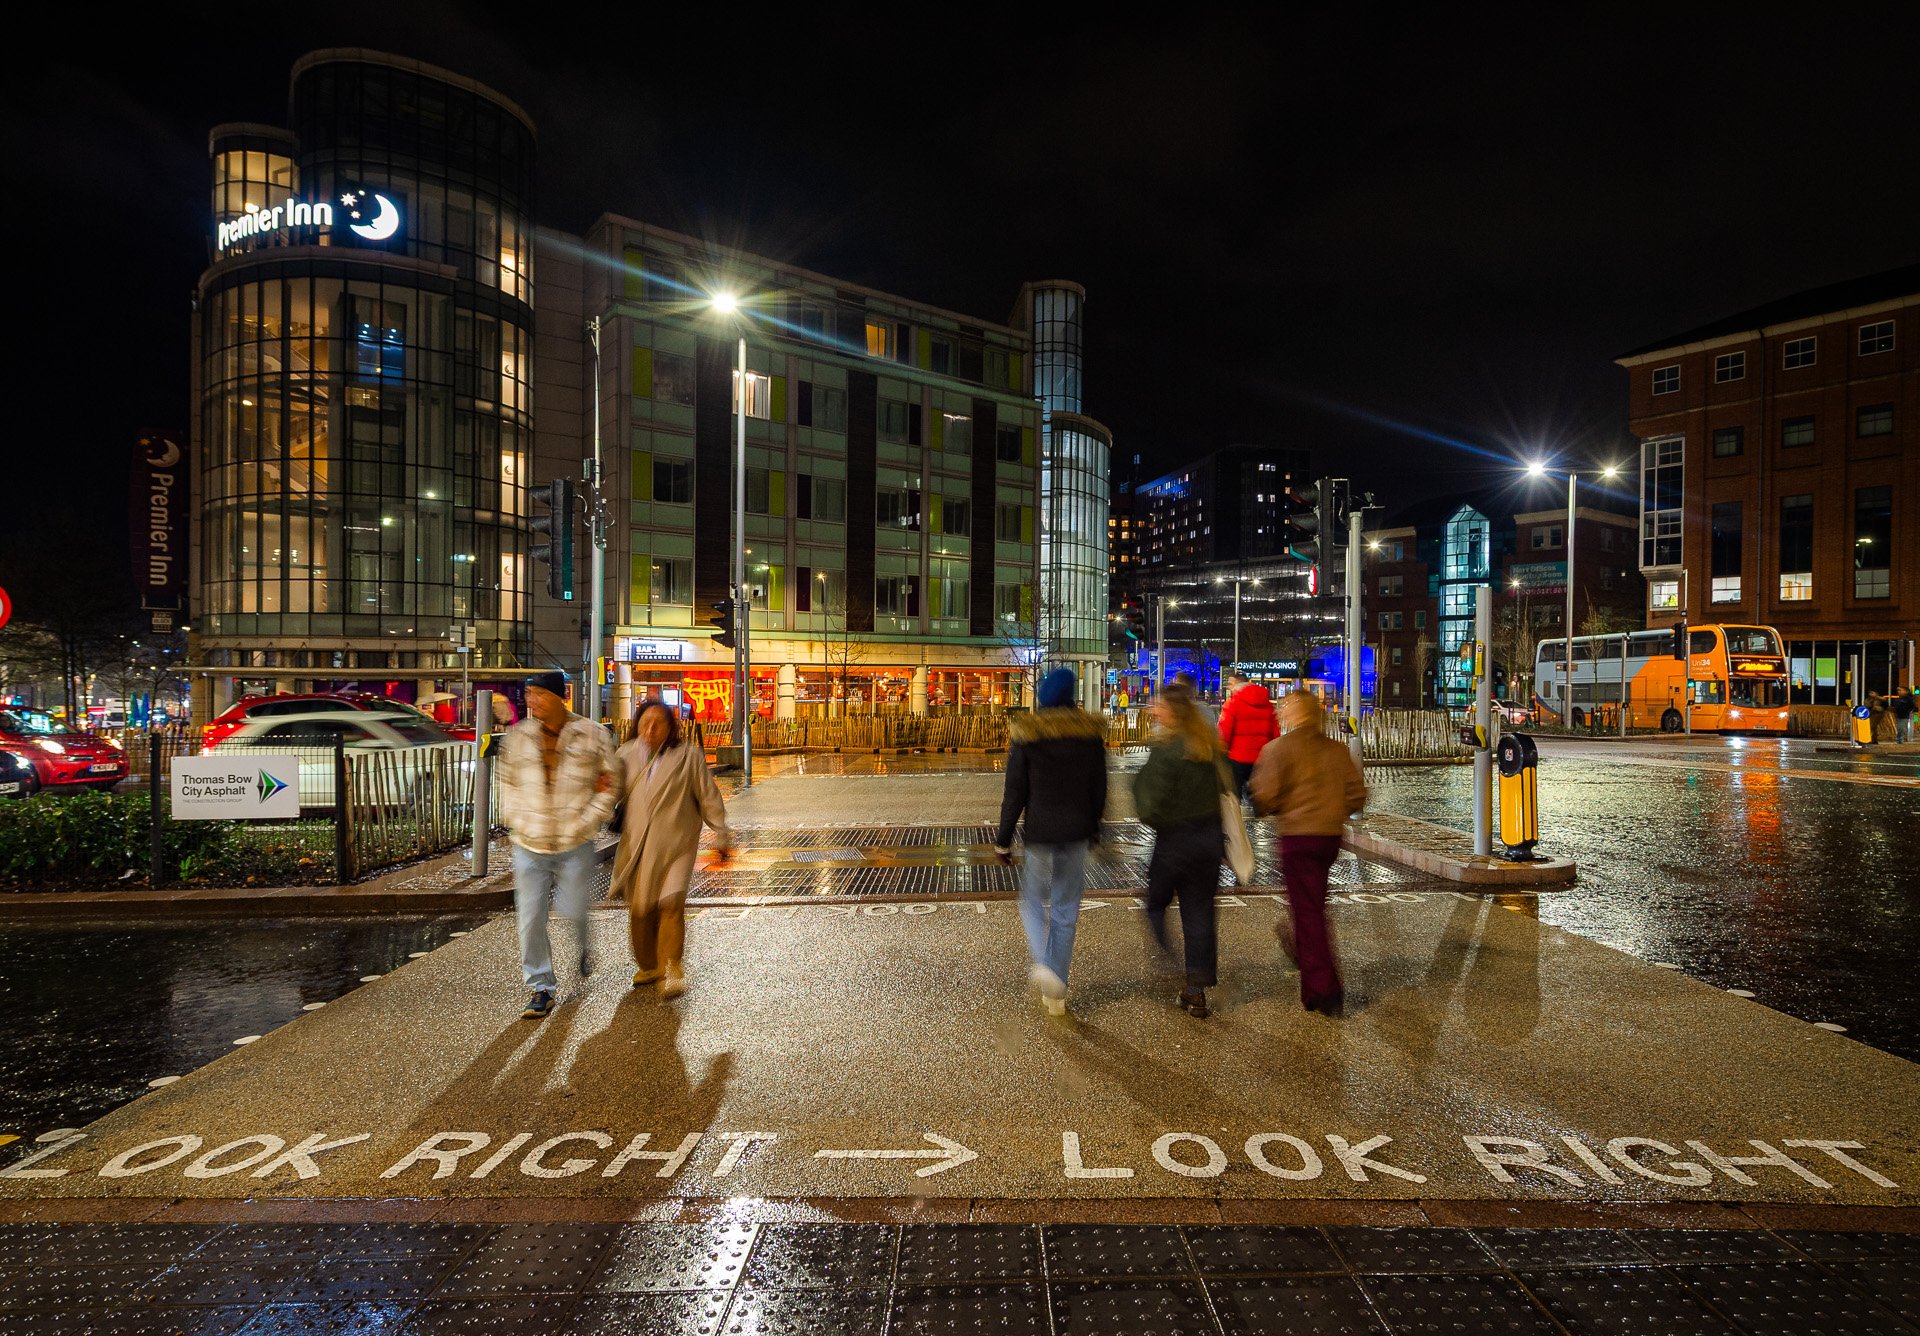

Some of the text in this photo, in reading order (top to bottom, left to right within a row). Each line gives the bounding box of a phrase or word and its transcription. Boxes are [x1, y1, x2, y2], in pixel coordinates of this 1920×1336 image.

[218, 198, 333, 251] Premier Inn
[150, 473, 174, 552] Premier
[150, 556, 173, 586] Inn
[1268, 662, 1297, 670] CASINOS
[182, 774, 252, 785] Thomas Bow
[182, 786, 246, 798] City Asphalt
[0, 1130, 1899, 1189] LOOK RIGHT LOOK RIGHT
